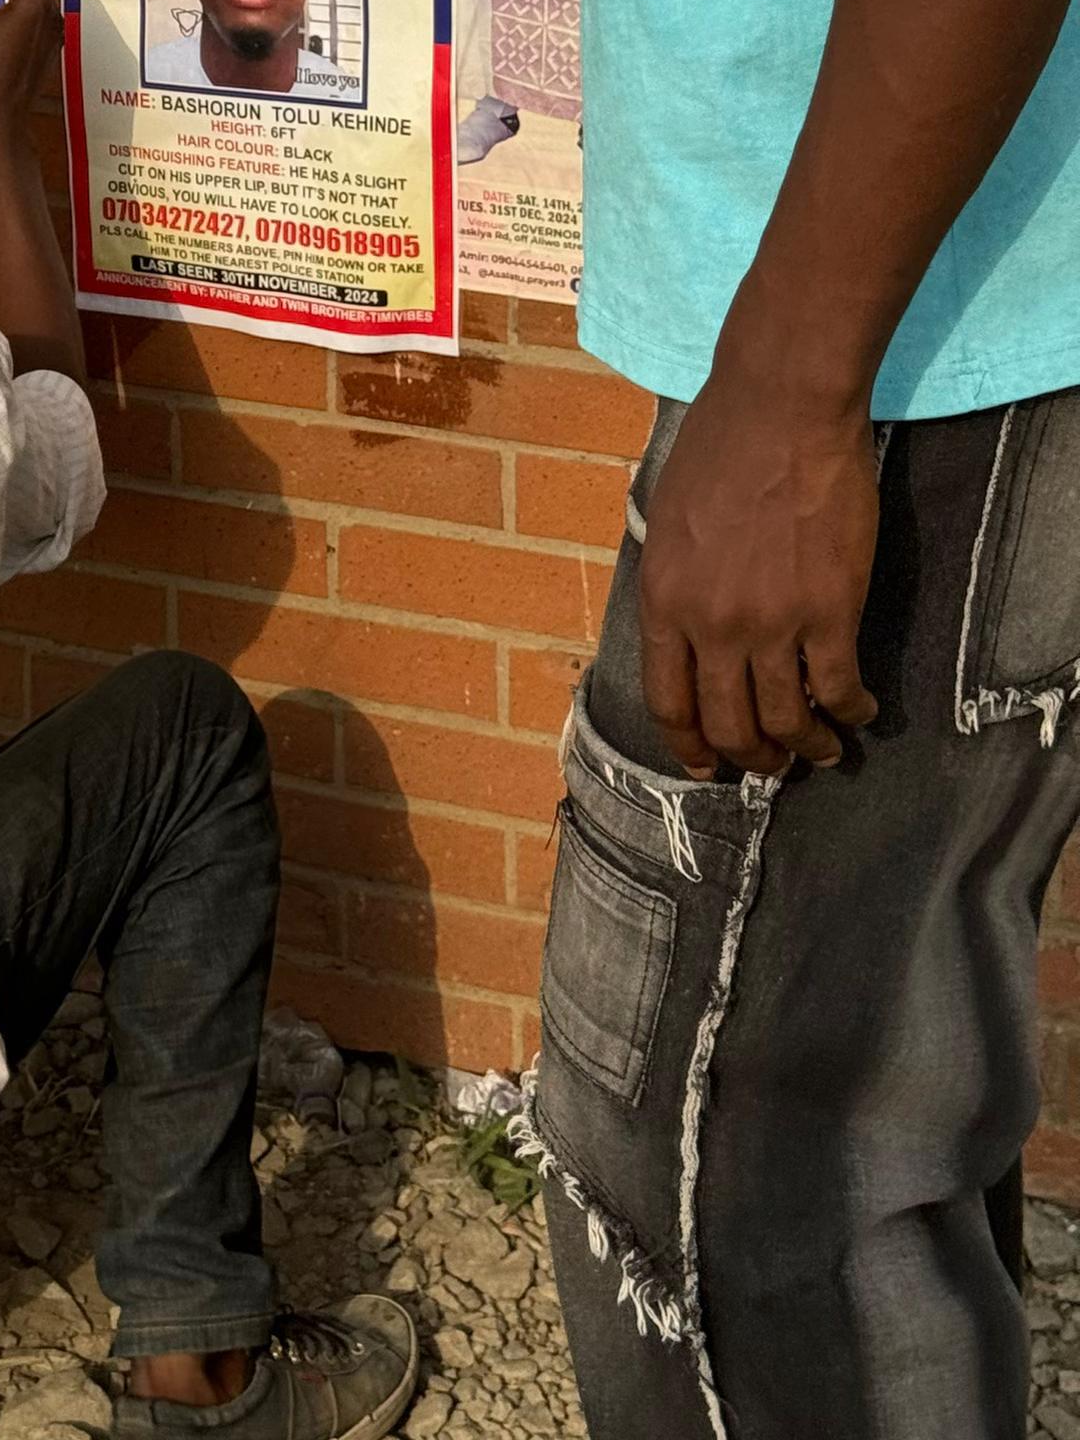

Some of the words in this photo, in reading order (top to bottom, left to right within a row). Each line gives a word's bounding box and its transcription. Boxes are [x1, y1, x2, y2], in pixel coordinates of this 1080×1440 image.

[304, 68, 337, 87] love
[101, 88, 156, 109] NAME:
[161, 95, 261, 120] BASHORUN
[271, 106, 321, 126] TOLU
[331, 111, 412, 136] KEHINDE
[211, 120, 267, 137] HEIGHT:
[270, 127, 296, 140] 6FT
[109, 144, 215, 168] DISTINGUISHING
[219, 157, 285, 177] FEATURE:
[289, 166, 308, 179] HE
[312, 168, 339, 184] HAS
[342, 172, 352, 186] A
[355, 174, 407, 191] SLIGHT
[177, 134, 211, 149] HAIR
[214, 138, 279, 157] COLOUR:
[283, 146, 333, 163] BLACK
[108, 179, 169, 201] OBVIOUS,
[172, 190, 200, 204] YOU
[204, 193, 236, 208] WILL
[240, 197, 277, 213] HAVE
[280, 202, 299, 216] TO
[302, 205, 339, 222] LOOK
[342, 211, 411, 229] CLOSELY.
[118, 163, 144, 178] CUT
[148, 166, 166, 181] ON
[170, 169, 191, 184] HIS
[195, 173, 240, 190] UPPER
[245, 179, 267, 195] LIP,
[271, 182, 299, 197] BUT
[302, 186, 325, 201] IT'S
[329, 190, 357, 205] NOT
[360, 194, 398, 209] THAT
[102, 197, 250, 242] 07034272427,
[255, 217, 420, 258] 07089618905
[489, 203, 517, 218] 31ST
[547, 211, 578, 225] 2024
[511, 222, 581, 240] GOVERNOR
[99, 224, 121, 236] PLS
[124, 227, 151, 241] CALL
[154, 232, 176, 245] THE
[178, 235, 234, 253] NUMBERS
[236, 245, 280, 260] ABOVE,
[283, 249, 303, 261] PIN
[305, 254, 325, 266] HIM
[327, 257, 364, 271] DOWN
[368, 262, 386, 273] OR
[390, 263, 425, 274] TAKE
[150, 246, 170, 257] HIM
[173, 248, 188, 259] TO
[191, 252, 211, 264] THE
[214, 255, 270, 271] NEAREST
[272, 261, 313, 278] POLICE
[316, 270, 364, 285] STATION
[96, 271, 188, 292] ANNOUNCEMENT
[210, 288, 251, 305] FATHER
[252, 295, 279, 308] AND
[280, 298, 310, 313] TWIN
[311, 303, 433, 323] BROTHER-TIMIVIBES
[140, 258, 175, 273] LAST
[178, 265, 218, 281] SEEN:
[221, 270, 255, 288] 30TH
[258, 275, 342, 301] NOVEMBER,
[344, 289, 379, 305] 2024
